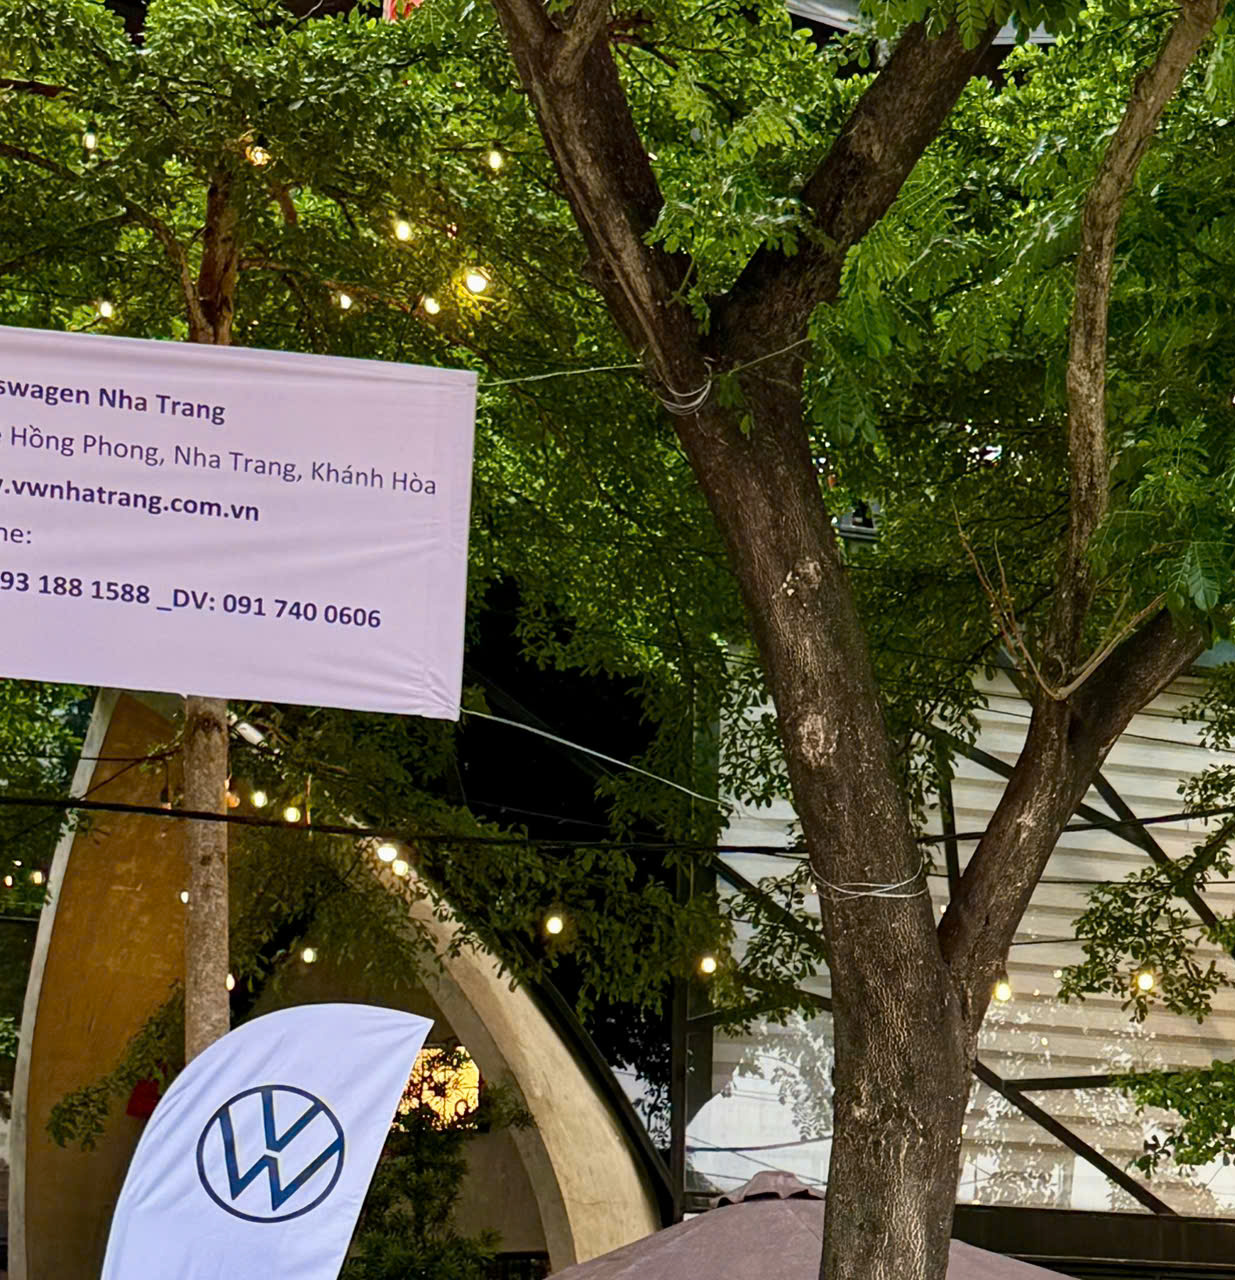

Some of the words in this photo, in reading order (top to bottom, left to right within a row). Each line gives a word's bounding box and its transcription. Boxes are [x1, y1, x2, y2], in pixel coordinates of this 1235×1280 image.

[98, 387, 148, 412] Nha
[155, 393, 227, 426] Trang
[10, 424, 75, 457] Hồng
[83, 434, 165, 468] Phong,
[174, 444, 221, 470] Nha
[228, 451, 303, 483] Trang,
[311, 461, 384, 489] Khánh
[392, 471, 436, 496] Hòa
[0, 479, 260, 522] .vwnhatrang.com.vn
[38, 574, 83, 598] 188
[91, 580, 151, 605] 1588
[222, 593, 267, 617] 091
[274, 598, 318, 622] 740
[323, 604, 381, 629] 0606
